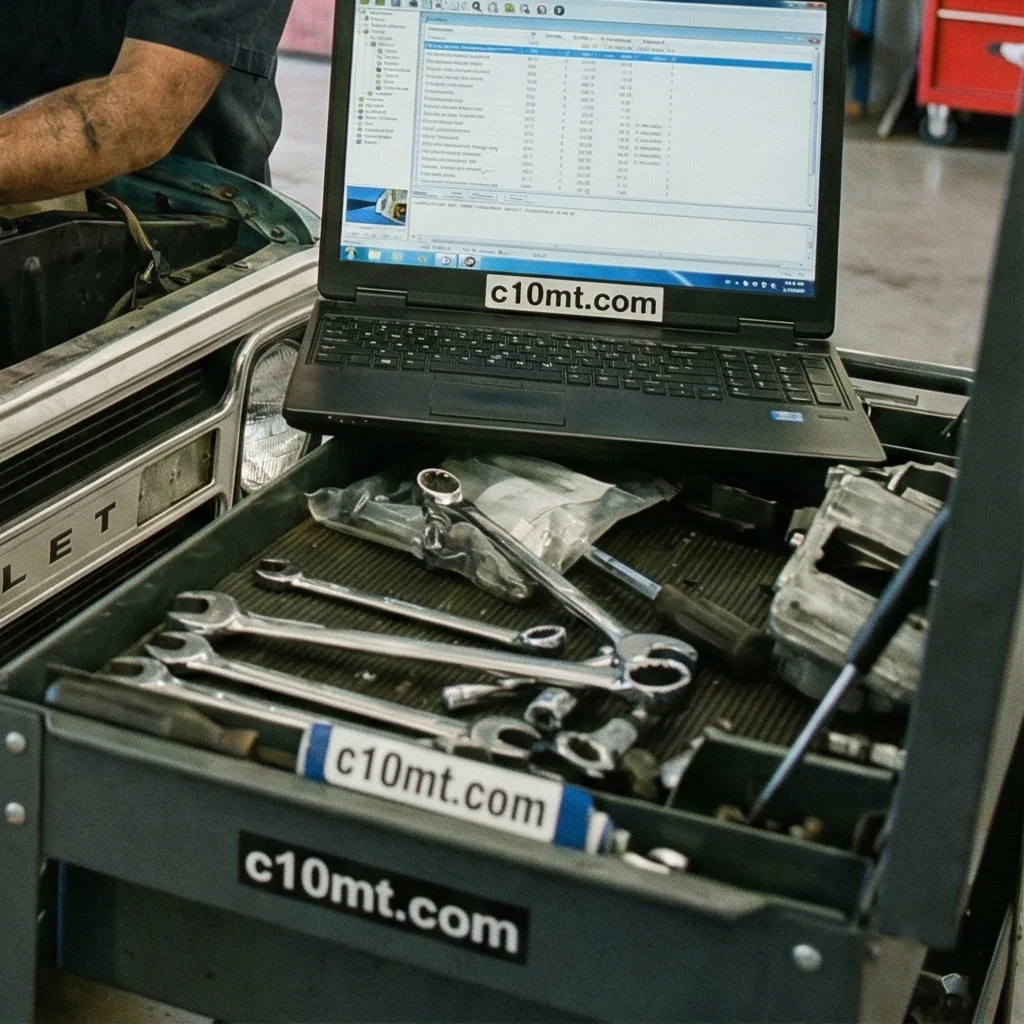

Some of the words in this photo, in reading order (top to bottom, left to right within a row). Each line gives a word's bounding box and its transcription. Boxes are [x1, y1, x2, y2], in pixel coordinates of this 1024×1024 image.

[491, 282, 657, 314] c10mt.com
[336, 745, 546, 827] c10mt.com
[244, 850, 519, 954] c10mt.com
